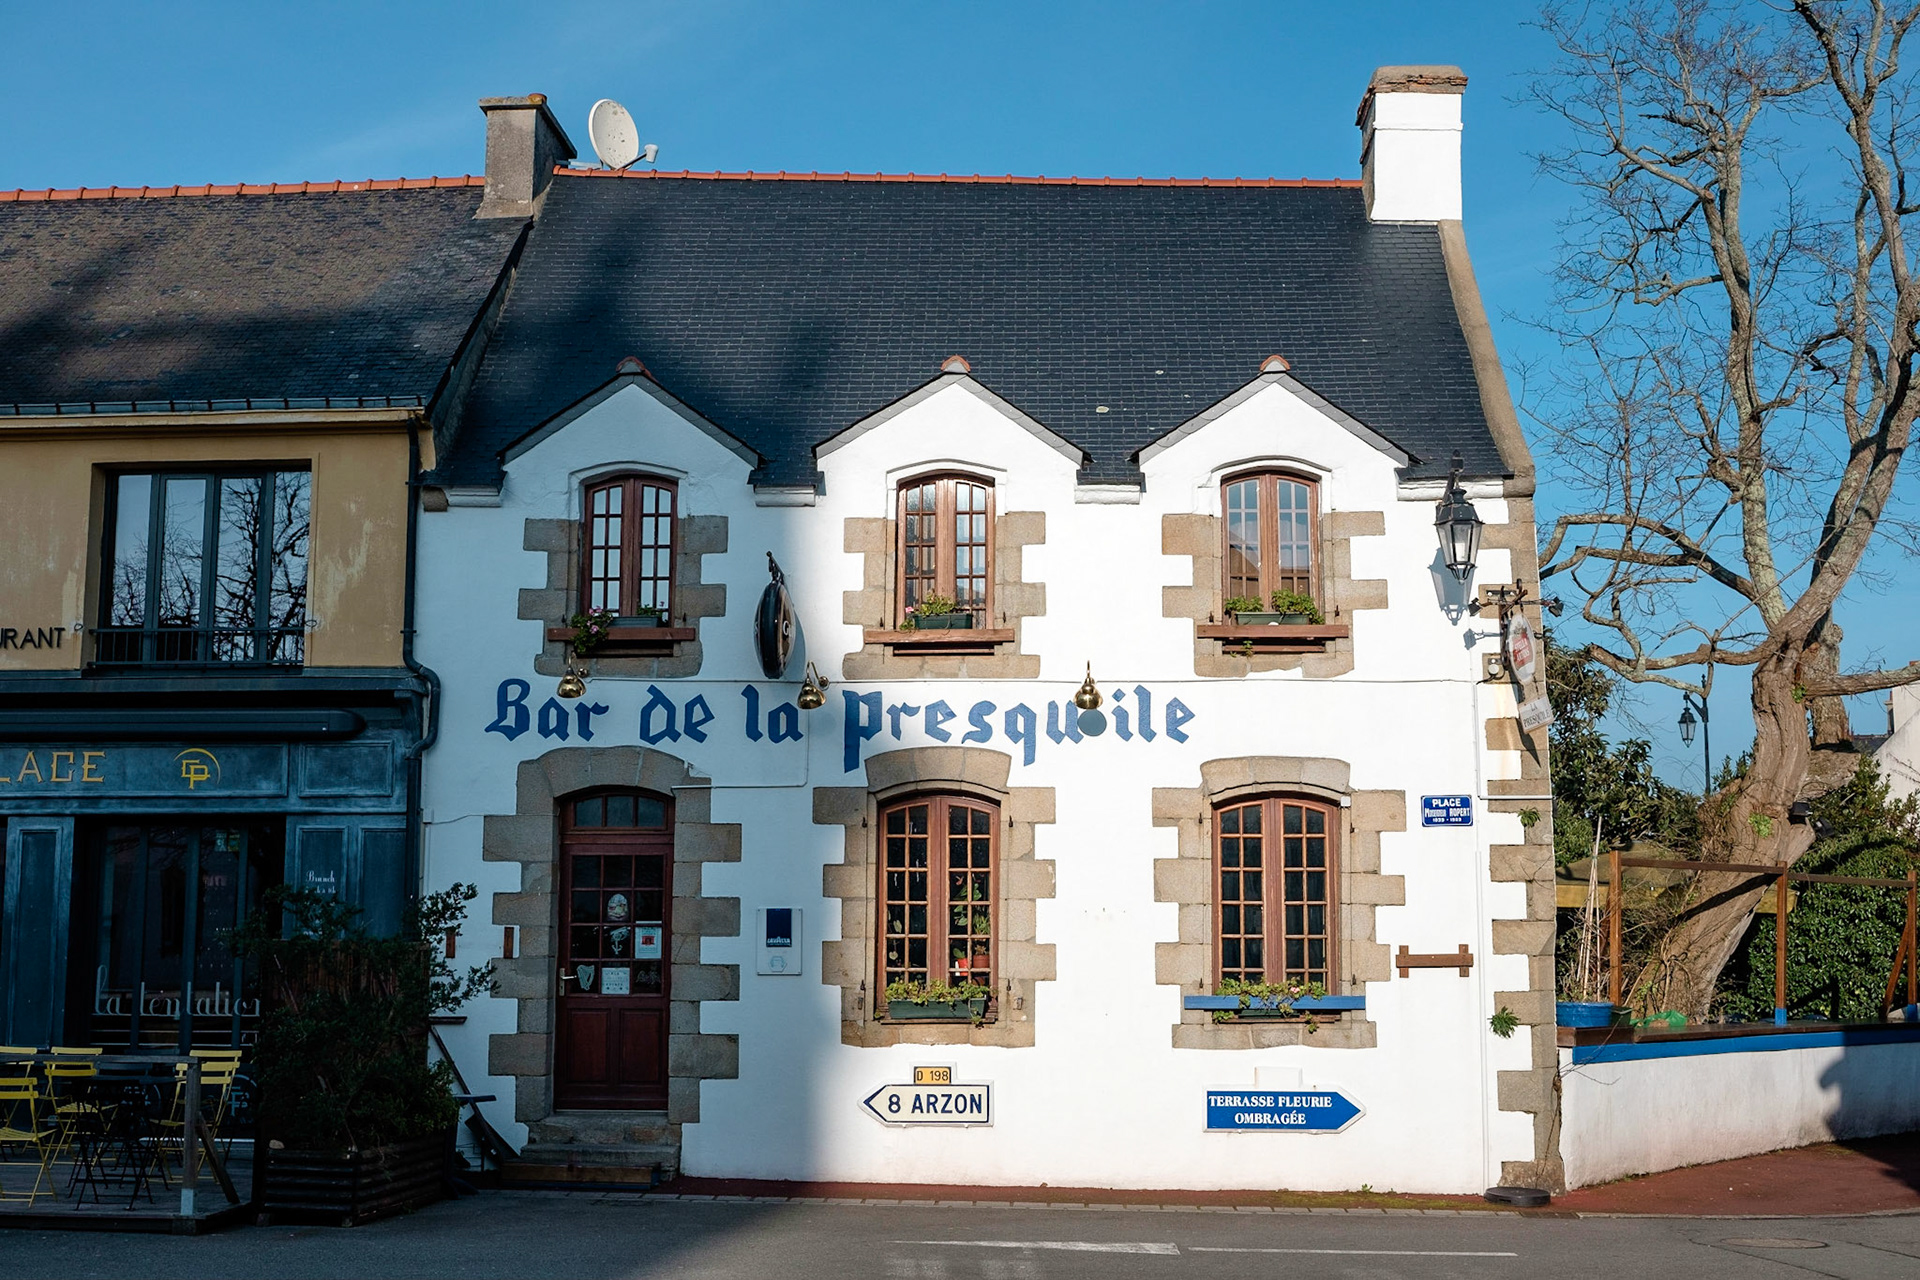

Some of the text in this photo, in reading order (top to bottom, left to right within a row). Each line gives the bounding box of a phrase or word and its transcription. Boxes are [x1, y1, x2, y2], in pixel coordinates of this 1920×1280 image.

[0, 627, 66, 649] RANT
[484, 678, 609, 742] Bar
[639, 684, 715, 745] de
[741, 684, 804, 743] la
[1432, 798, 1461, 807] PLACE
[916, 1070, 949, 1081] D 198
[888, 1093, 982, 1114] 8 ARZON
[1209, 1096, 1332, 1108] TERRASSE FLEURIE
[1234, 1110, 1306, 1125] OMBRAGÉE
